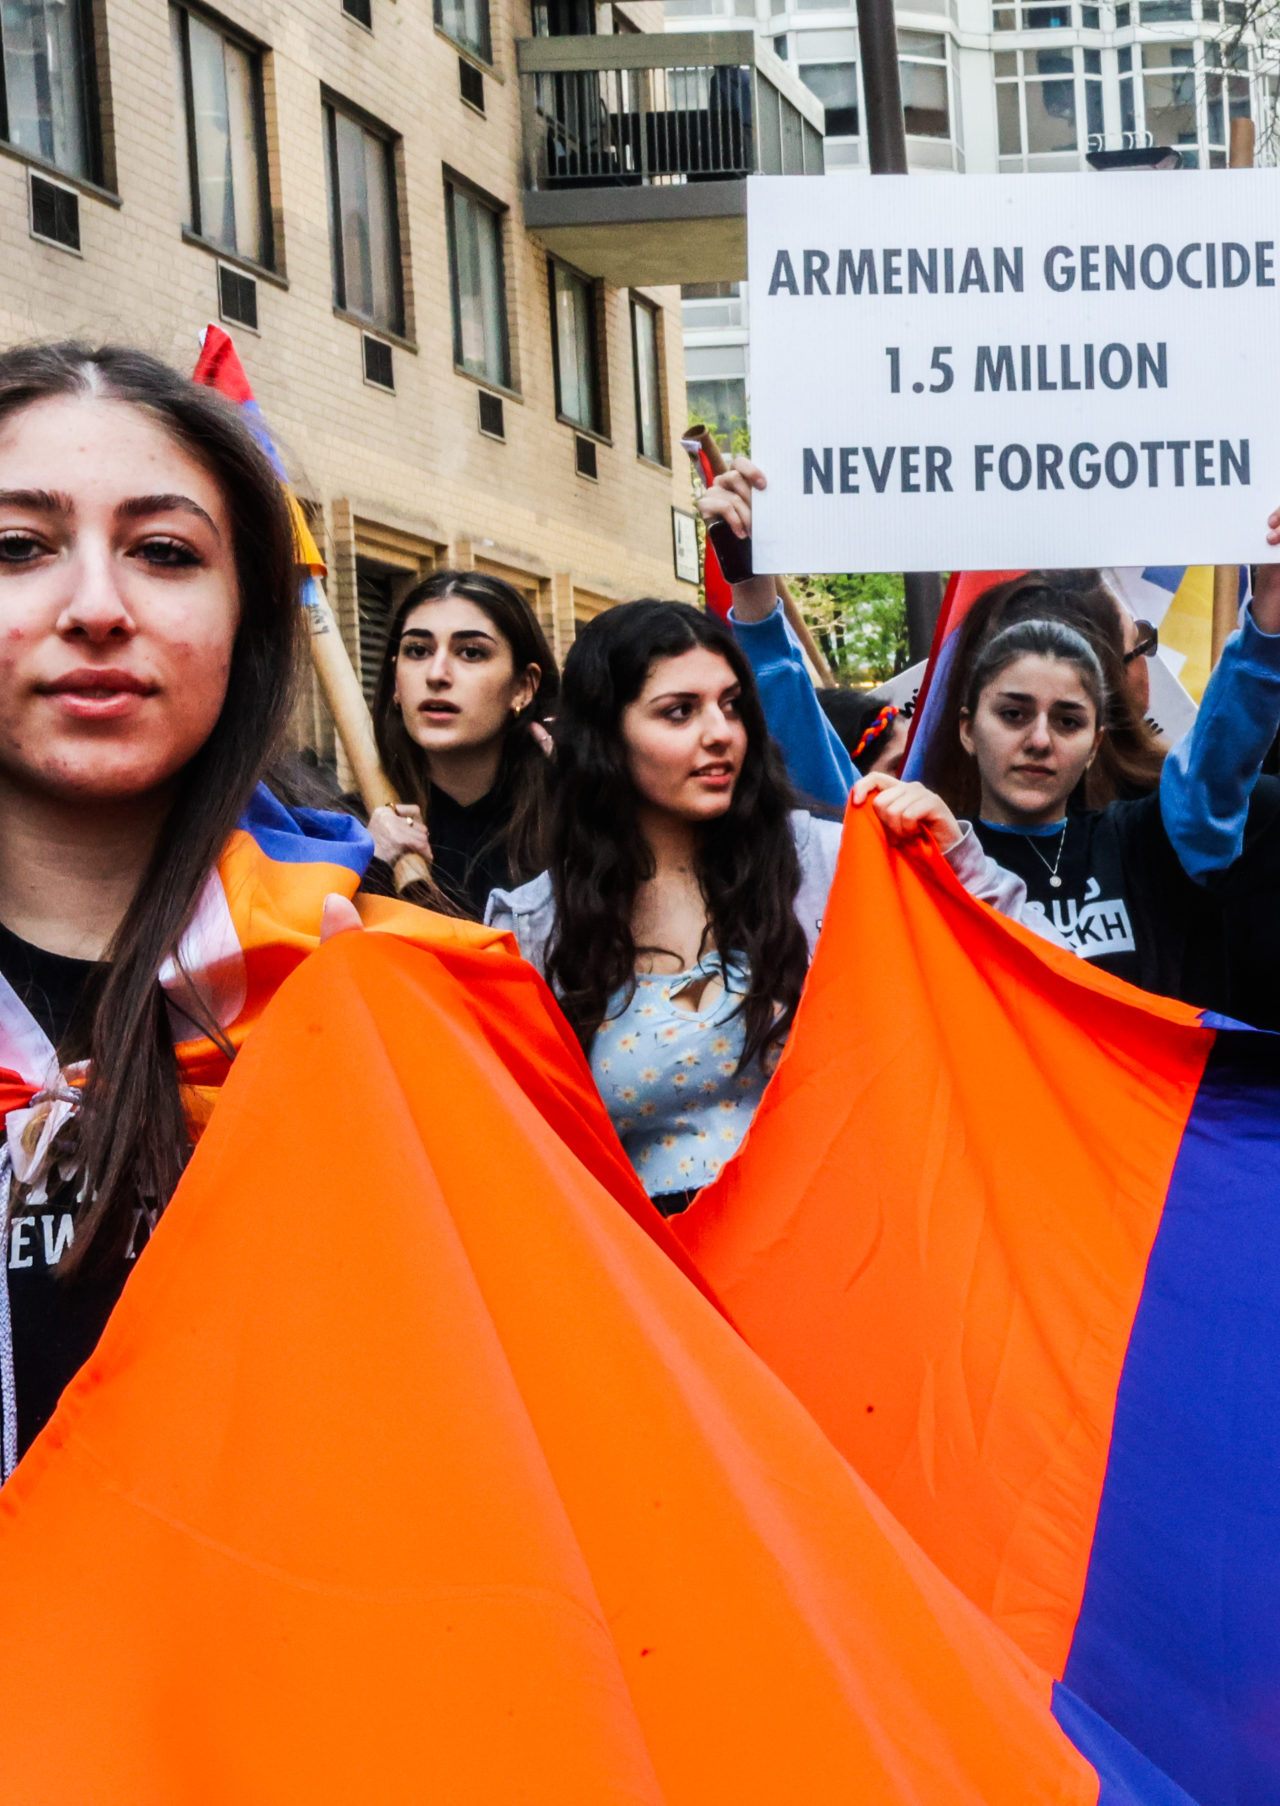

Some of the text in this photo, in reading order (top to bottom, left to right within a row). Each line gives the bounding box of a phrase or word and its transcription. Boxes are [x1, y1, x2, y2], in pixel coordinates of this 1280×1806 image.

[768, 241, 1275, 296] ARMENIAN GENOCIDE
[885, 342, 1168, 394] 1.5 MILLION
[802, 439, 1251, 495] NEVER FORGOTTEN
[1069, 912, 1127, 948] KH
